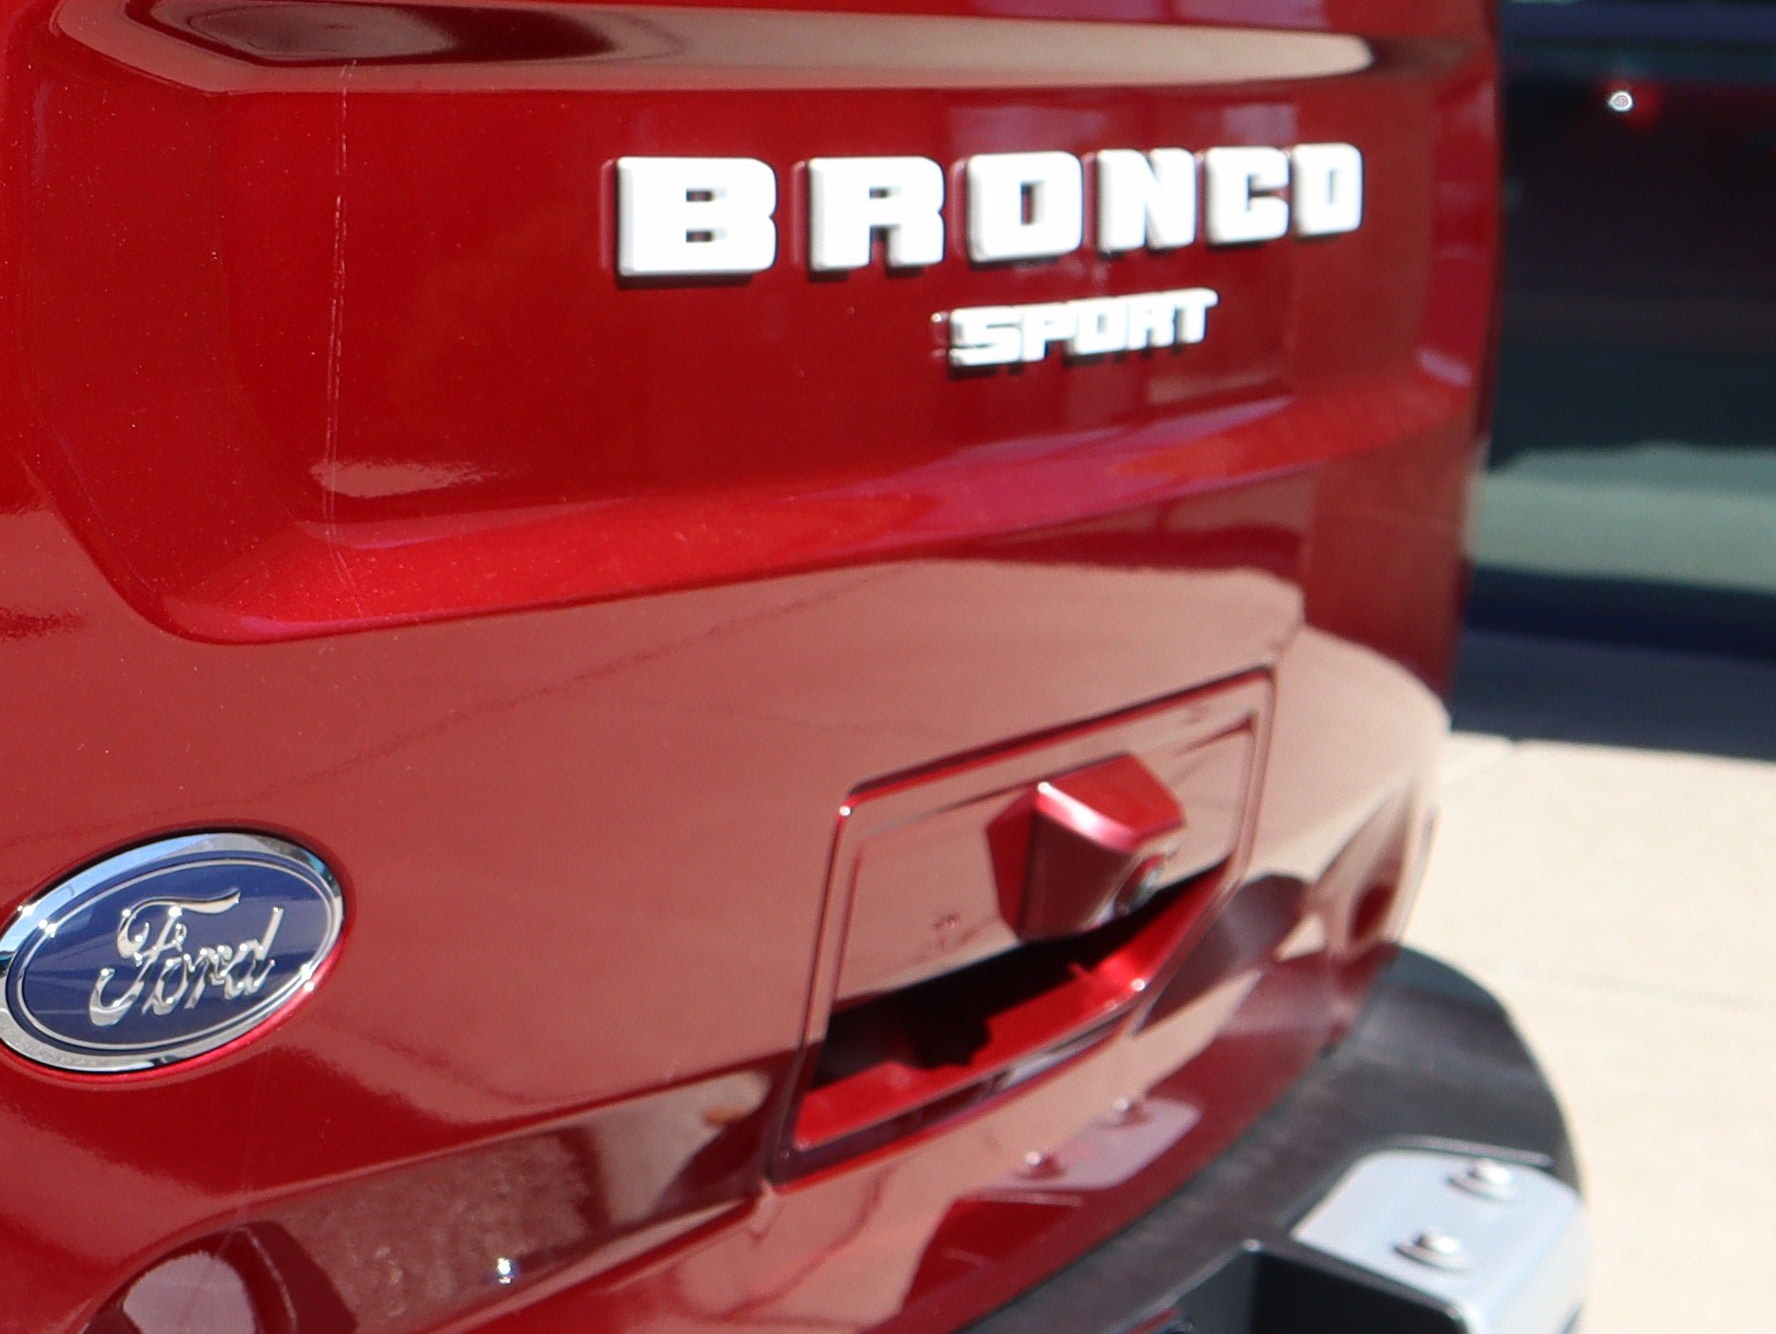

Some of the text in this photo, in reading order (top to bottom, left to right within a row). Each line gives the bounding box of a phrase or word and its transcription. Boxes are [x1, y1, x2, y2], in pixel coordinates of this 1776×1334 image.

[614, 142, 1364, 278] BRONCO
[948, 287, 1219, 368] SPORT
[88, 885, 285, 1027] Ford
